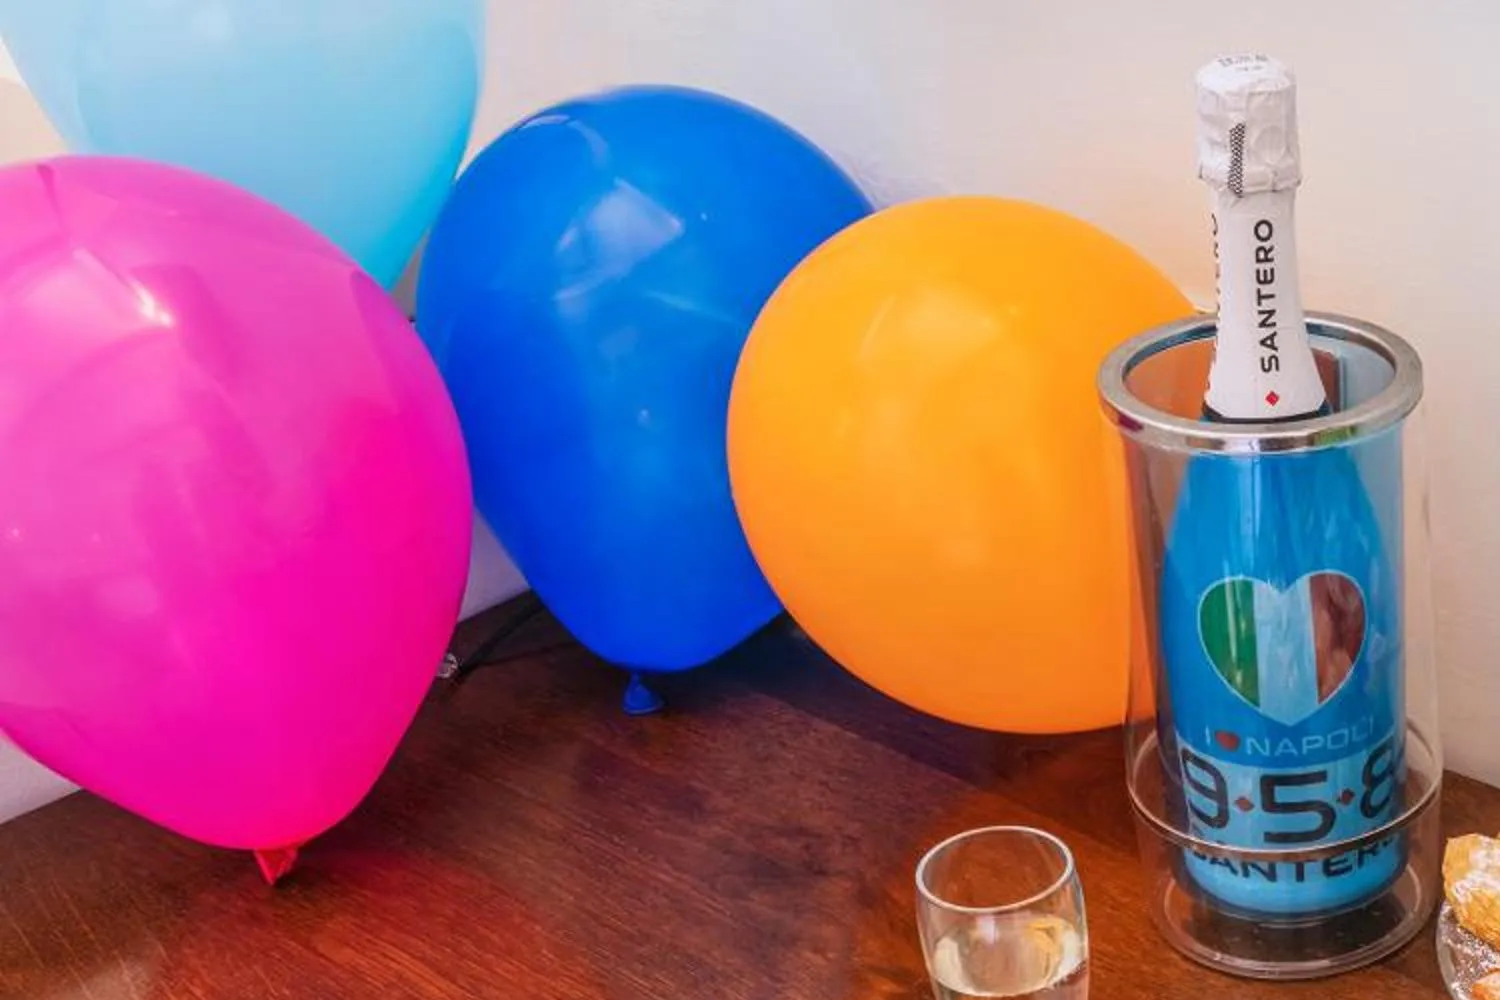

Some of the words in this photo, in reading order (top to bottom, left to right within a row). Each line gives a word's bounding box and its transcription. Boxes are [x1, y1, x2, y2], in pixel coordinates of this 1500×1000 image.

[1253, 219, 1279, 373] SANTERO
[1246, 715, 1374, 756] NAPOLI
[1192, 829, 1395, 882] ANTER
